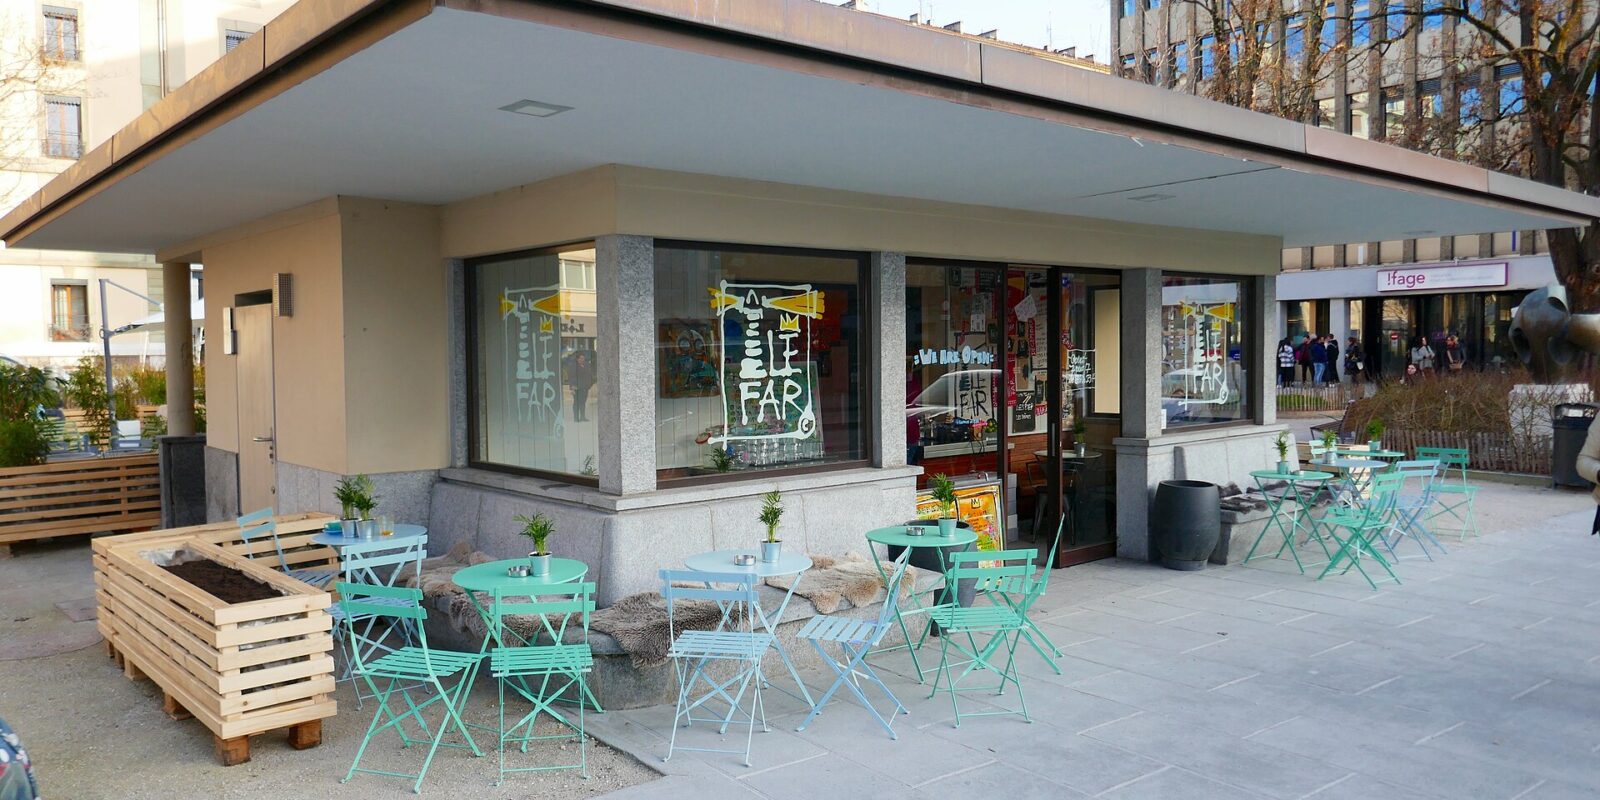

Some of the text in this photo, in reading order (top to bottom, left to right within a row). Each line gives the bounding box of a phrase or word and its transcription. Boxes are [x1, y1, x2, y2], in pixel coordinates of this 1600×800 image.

[767, 330, 802, 377] LE
[1193, 363, 1223, 394] FAR
[516, 381, 560, 423] FAR
[739, 378, 805, 426] FAR
[959, 390, 989, 419] FAR
